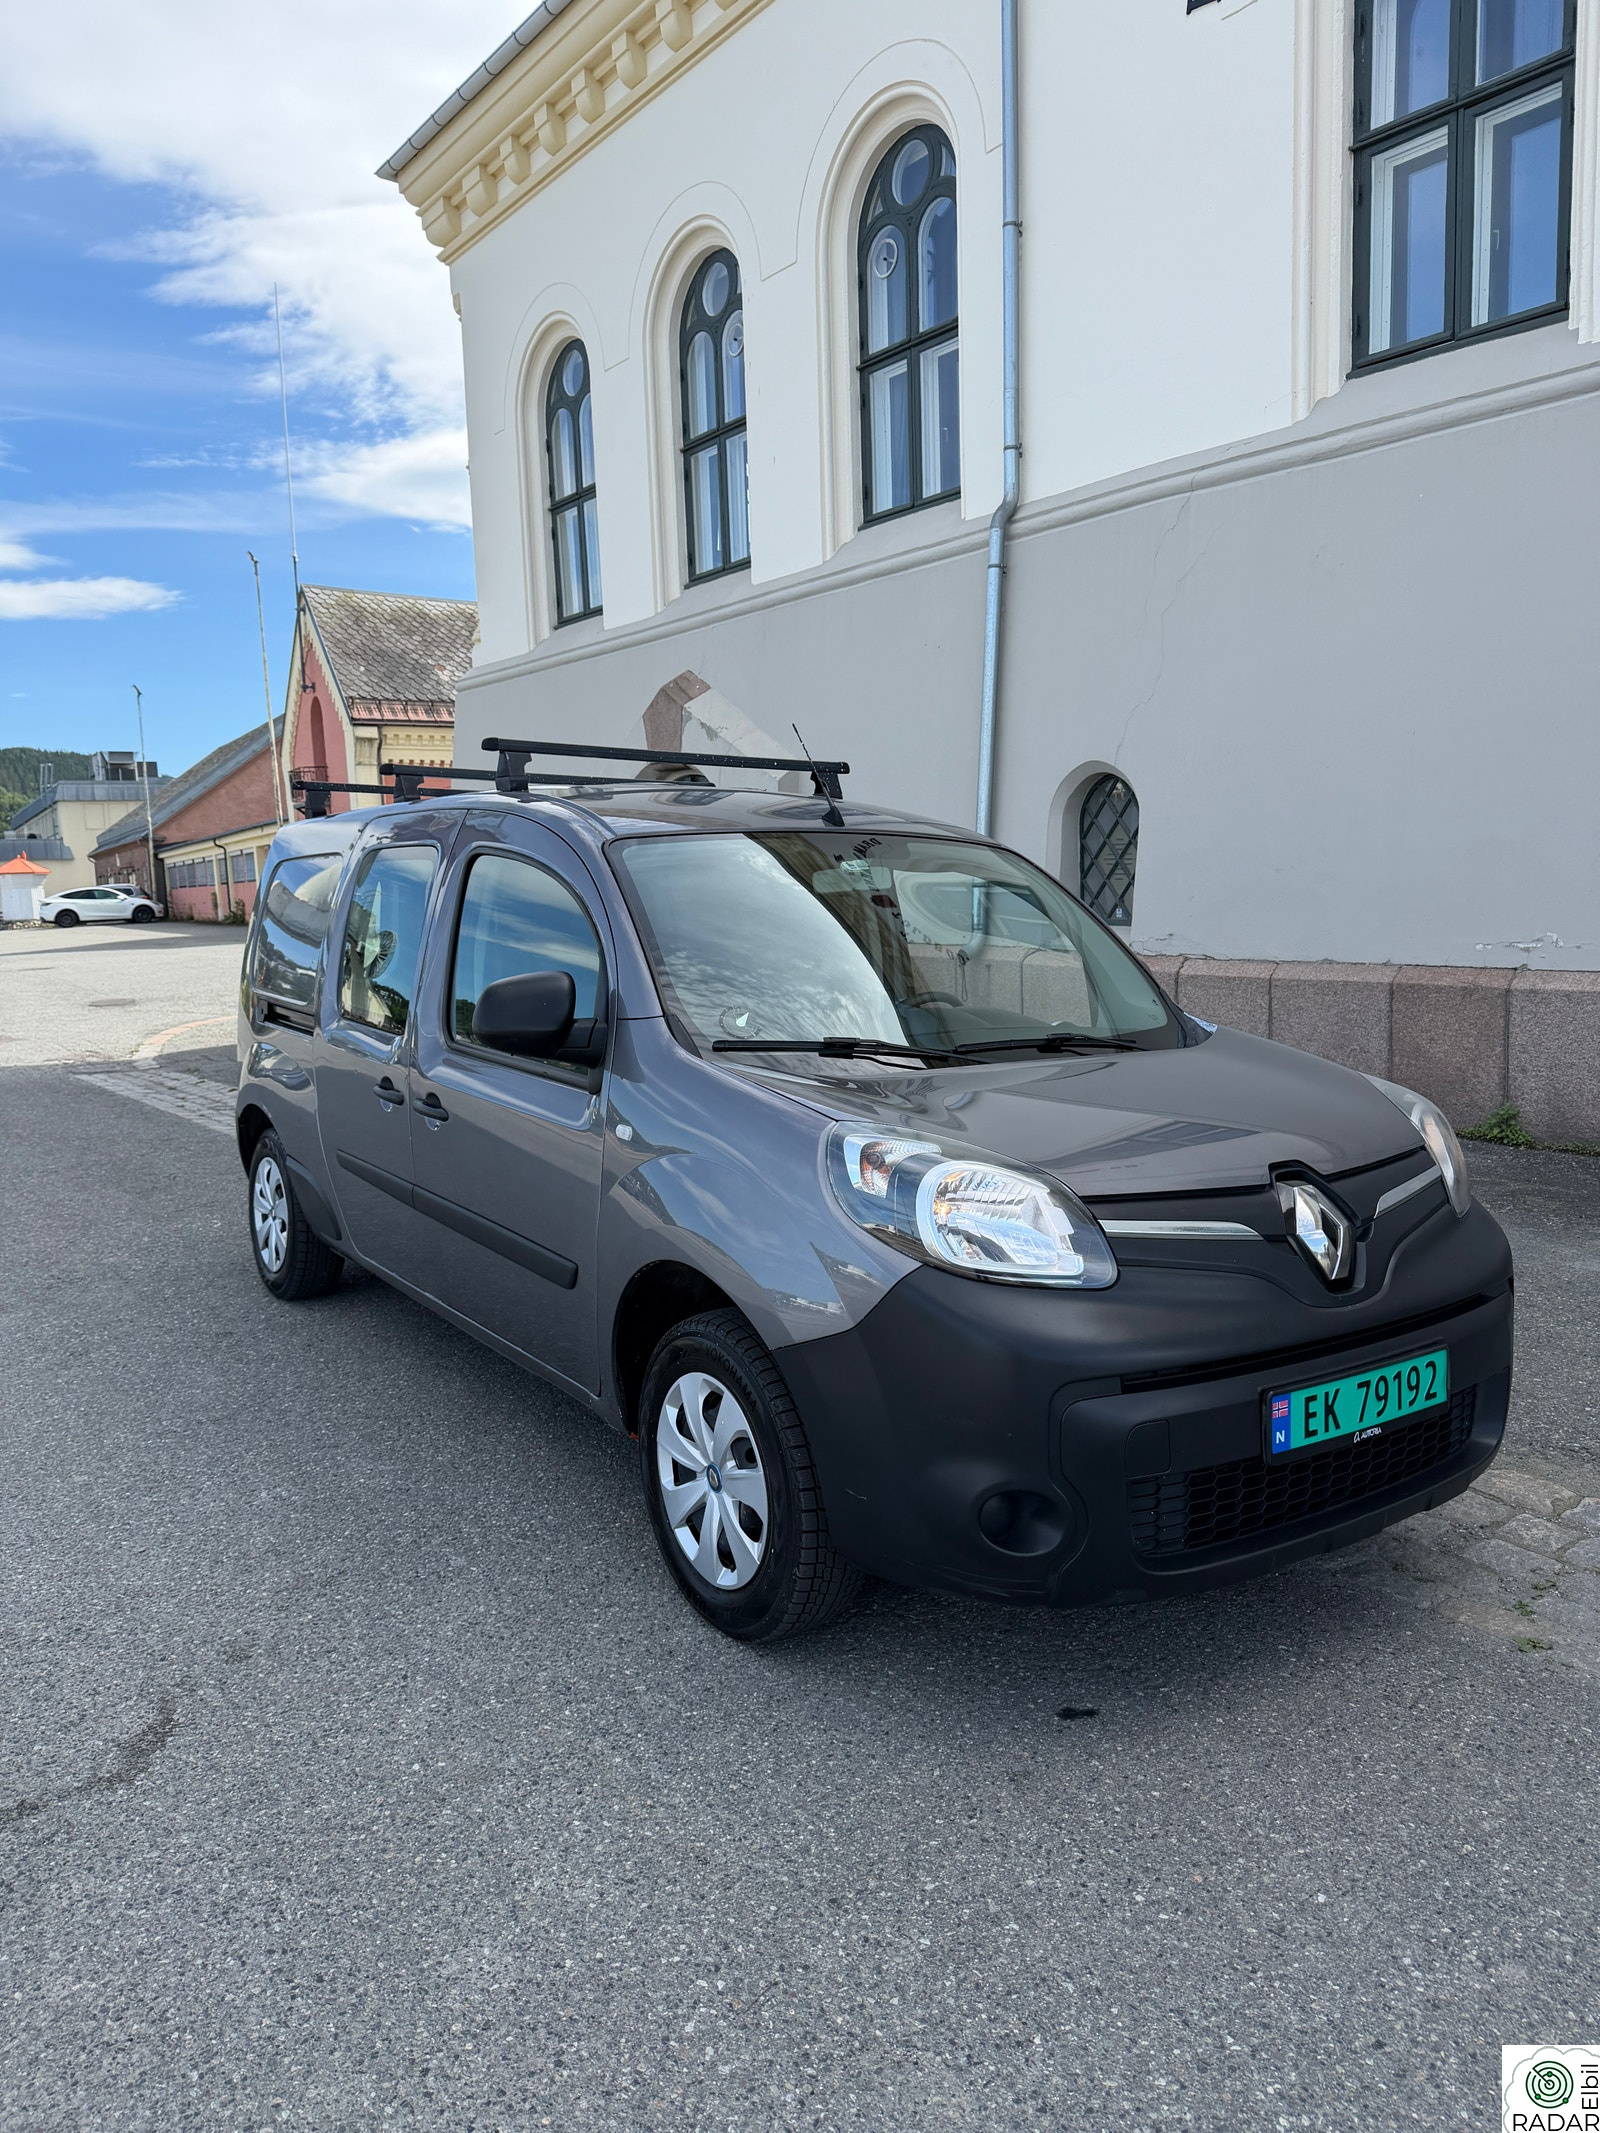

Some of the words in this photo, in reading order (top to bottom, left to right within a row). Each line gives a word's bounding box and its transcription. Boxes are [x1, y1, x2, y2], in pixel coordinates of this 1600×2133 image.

[1304, 1387, 1341, 1439] EK
[1356, 1360, 1437, 1424] 79192
[1275, 1429, 1285, 1444] N
